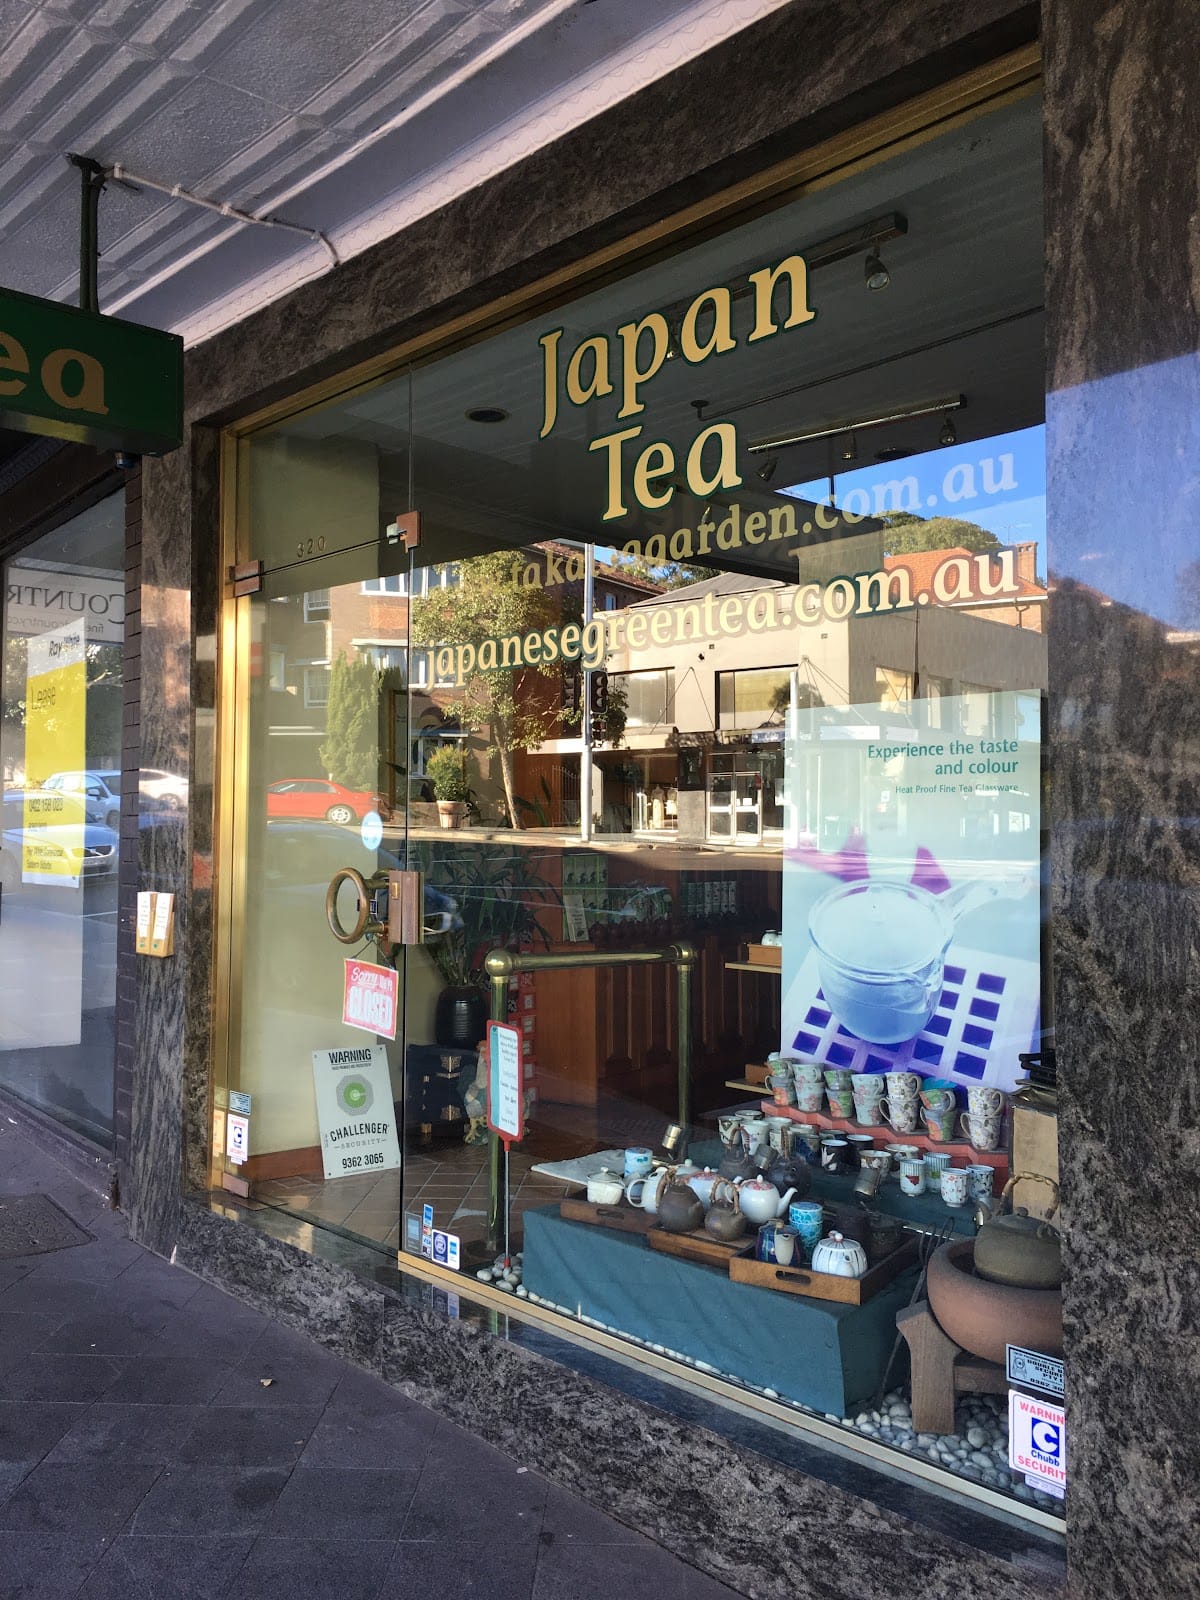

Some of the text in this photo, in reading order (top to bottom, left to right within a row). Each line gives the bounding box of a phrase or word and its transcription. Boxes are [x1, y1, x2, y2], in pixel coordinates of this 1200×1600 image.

[538, 254, 816, 439] Japan
[588, 422, 743, 521] Tea
[296, 535, 327, 558] 320
[424, 549, 1021, 691] japanesegreentea.com.au
[868, 738, 1019, 762] Experience the taste
[935, 758, 1019, 775] and colour
[895, 783, 1019, 794] Heat Proof Fine Tea Glassware
[328, 1048, 372, 1064] WARNING
[330, 1122, 389, 1142] CHALLENGER
[341, 1152, 385, 1169] 9362 3065
[1019, 1400, 1065, 1425] WARNIN
[1018, 1455, 1067, 1481] SECURIT
[1031, 1448, 1061, 1468] Chubb
